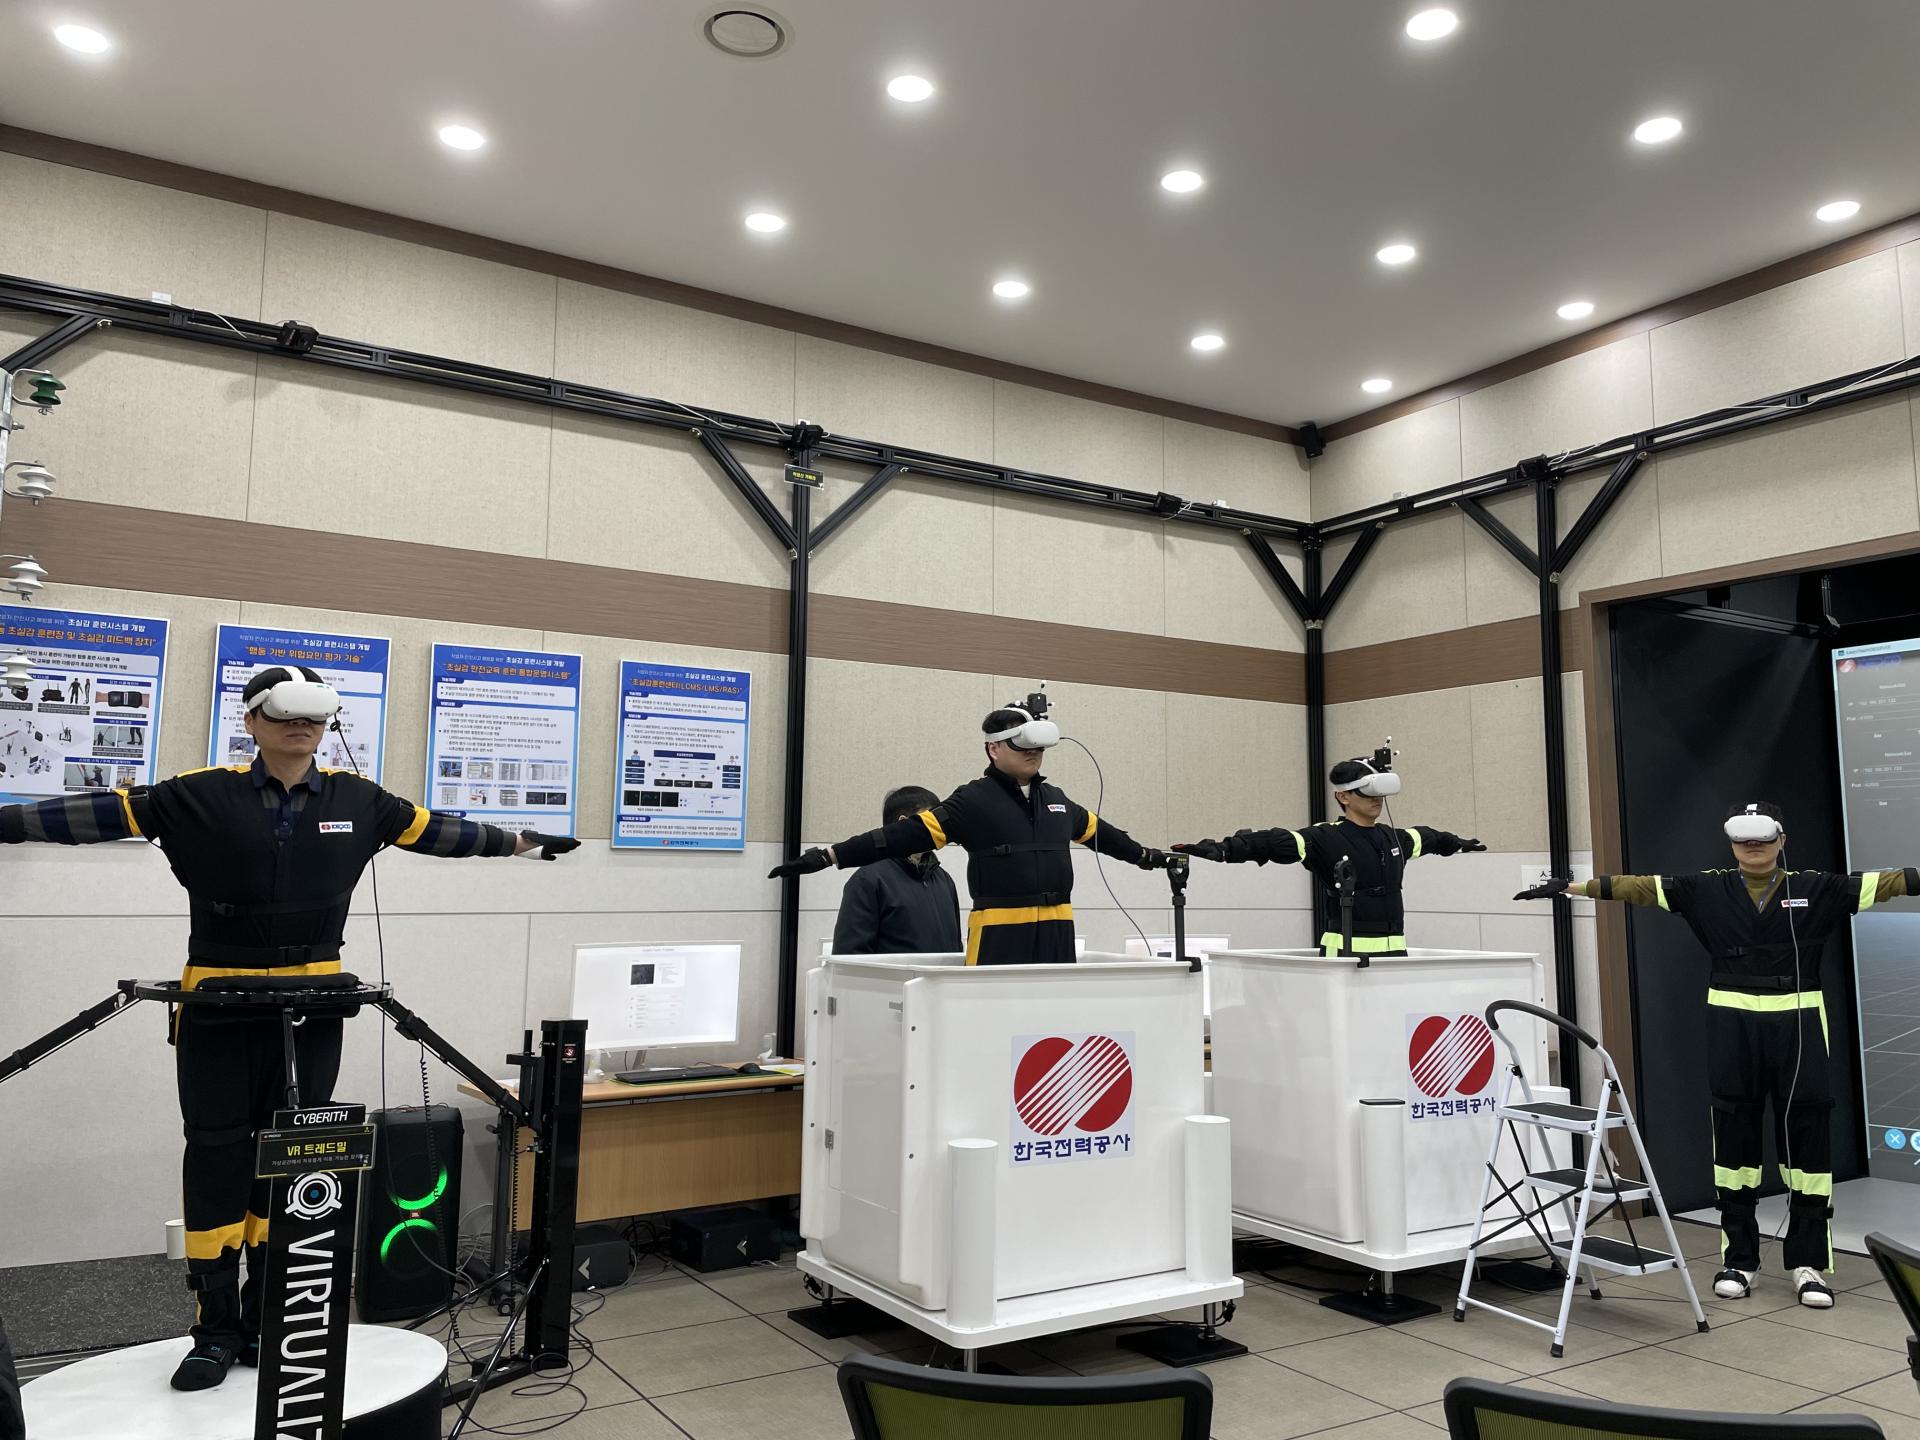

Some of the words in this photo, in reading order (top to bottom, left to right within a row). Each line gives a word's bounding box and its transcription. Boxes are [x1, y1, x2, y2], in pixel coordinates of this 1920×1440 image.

[68, 618, 90, 628] 초실감
[92, 621, 129, 631] 훈련시스템
[131, 624, 146, 633] 개발
[8, 626, 35, 637] 초실감
[78, 632, 104, 643] 초실감
[303, 639, 323, 647] 초실감
[324, 640, 356, 650] 훈련시스템
[357, 643, 371, 651] 개발
[270, 647, 286, 658] 기반
[289, 650, 323, 660] 위험요인
[325, 652, 341, 662] 평가
[506, 656, 523, 664] 초실감
[524, 658, 552, 667] 훈련시스템
[1411, 1096, 1496, 1119] 한국전력공사
[293, 1110, 349, 1126] CYBERITH
[287, 1145, 301, 1157] VR
[304, 1141, 347, 1155] 트레드밀
[1013, 1133, 1131, 1162] 한국전력공사
